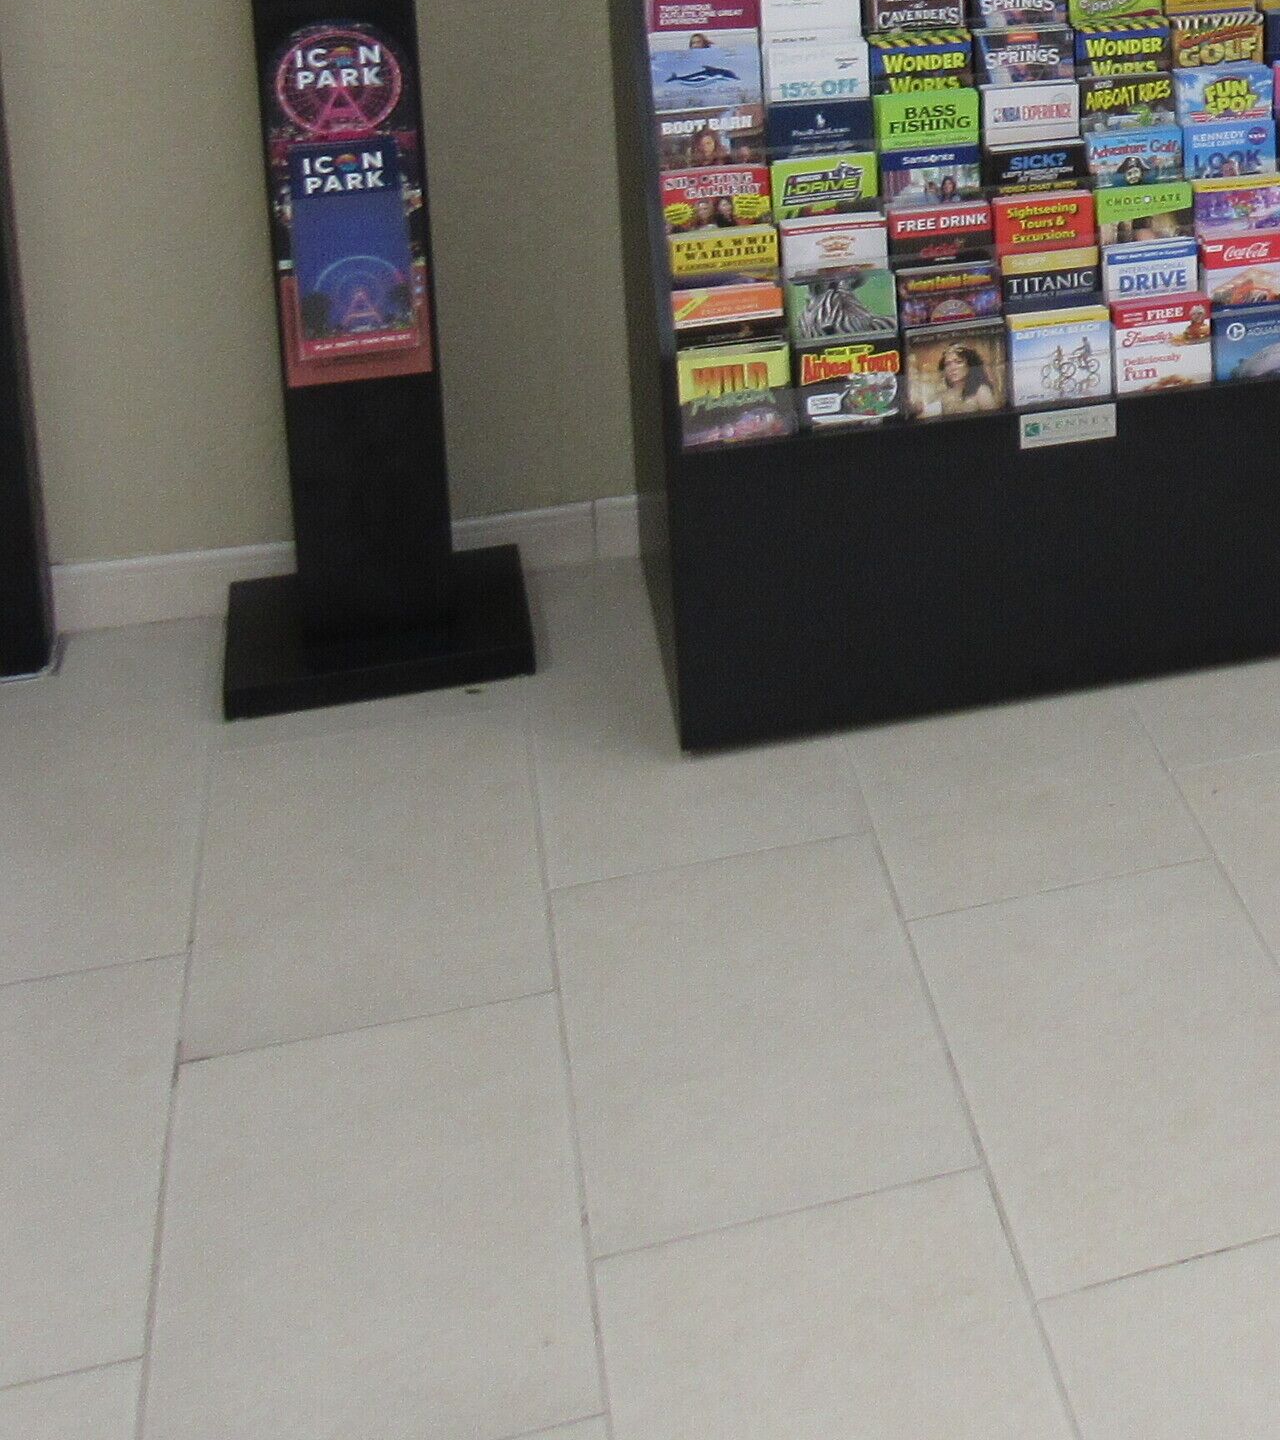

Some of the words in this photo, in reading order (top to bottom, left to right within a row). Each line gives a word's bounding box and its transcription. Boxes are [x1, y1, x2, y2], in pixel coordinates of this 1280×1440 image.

[878, 7, 960, 29] CAVENDER'S
[1085, 37, 1163, 59] WONDER
[1179, 37, 1257, 68] GOLF
[882, 53, 966, 74] WONDER
[986, 49, 1060, 69] SPRINGS
[296, 66, 385, 90] PARK
[889, 76, 960, 93] WORKS
[779, 81, 816, 99] 15%
[821, 78, 859, 95] OFF
[1086, 83, 1139, 111] AIRBOAT
[1138, 79, 1172, 105] RIDES
[1204, 79, 1249, 103] FUN
[904, 103, 957, 120] BASS
[1205, 93, 1258, 116] SPOT
[661, 118, 707, 135] BOOT
[708, 115, 753, 131] BARN
[889, 115, 972, 135] FISHING
[1192, 130, 1245, 141] KENNEDY
[902, 152, 956, 165] Samsonite
[1009, 151, 1067, 171] SICK?
[305, 170, 386, 194] PARK
[787, 178, 857, 195] I-DRIVE
[1106, 193, 1182, 207] CHOCOLATE
[1007, 203, 1078, 220] Sightseeing
[897, 218, 936, 233] FREE
[940, 212, 987, 228] DRINK
[1019, 216, 1052, 229] Tours
[1055, 215, 1066, 226] &
[1012, 228, 1076, 244] Excursions
[675, 241, 706, 253] FLY
[685, 246, 767, 261] WARBIRD
[1008, 270, 1095, 295] TITANIC
[1119, 269, 1188, 293] DRIVE
[1146, 306, 1184, 321] FREE
[1016, 328, 1066, 341] DAYTONA
[854, 350, 900, 375] Tours
[1123, 366, 1159, 382] fun
